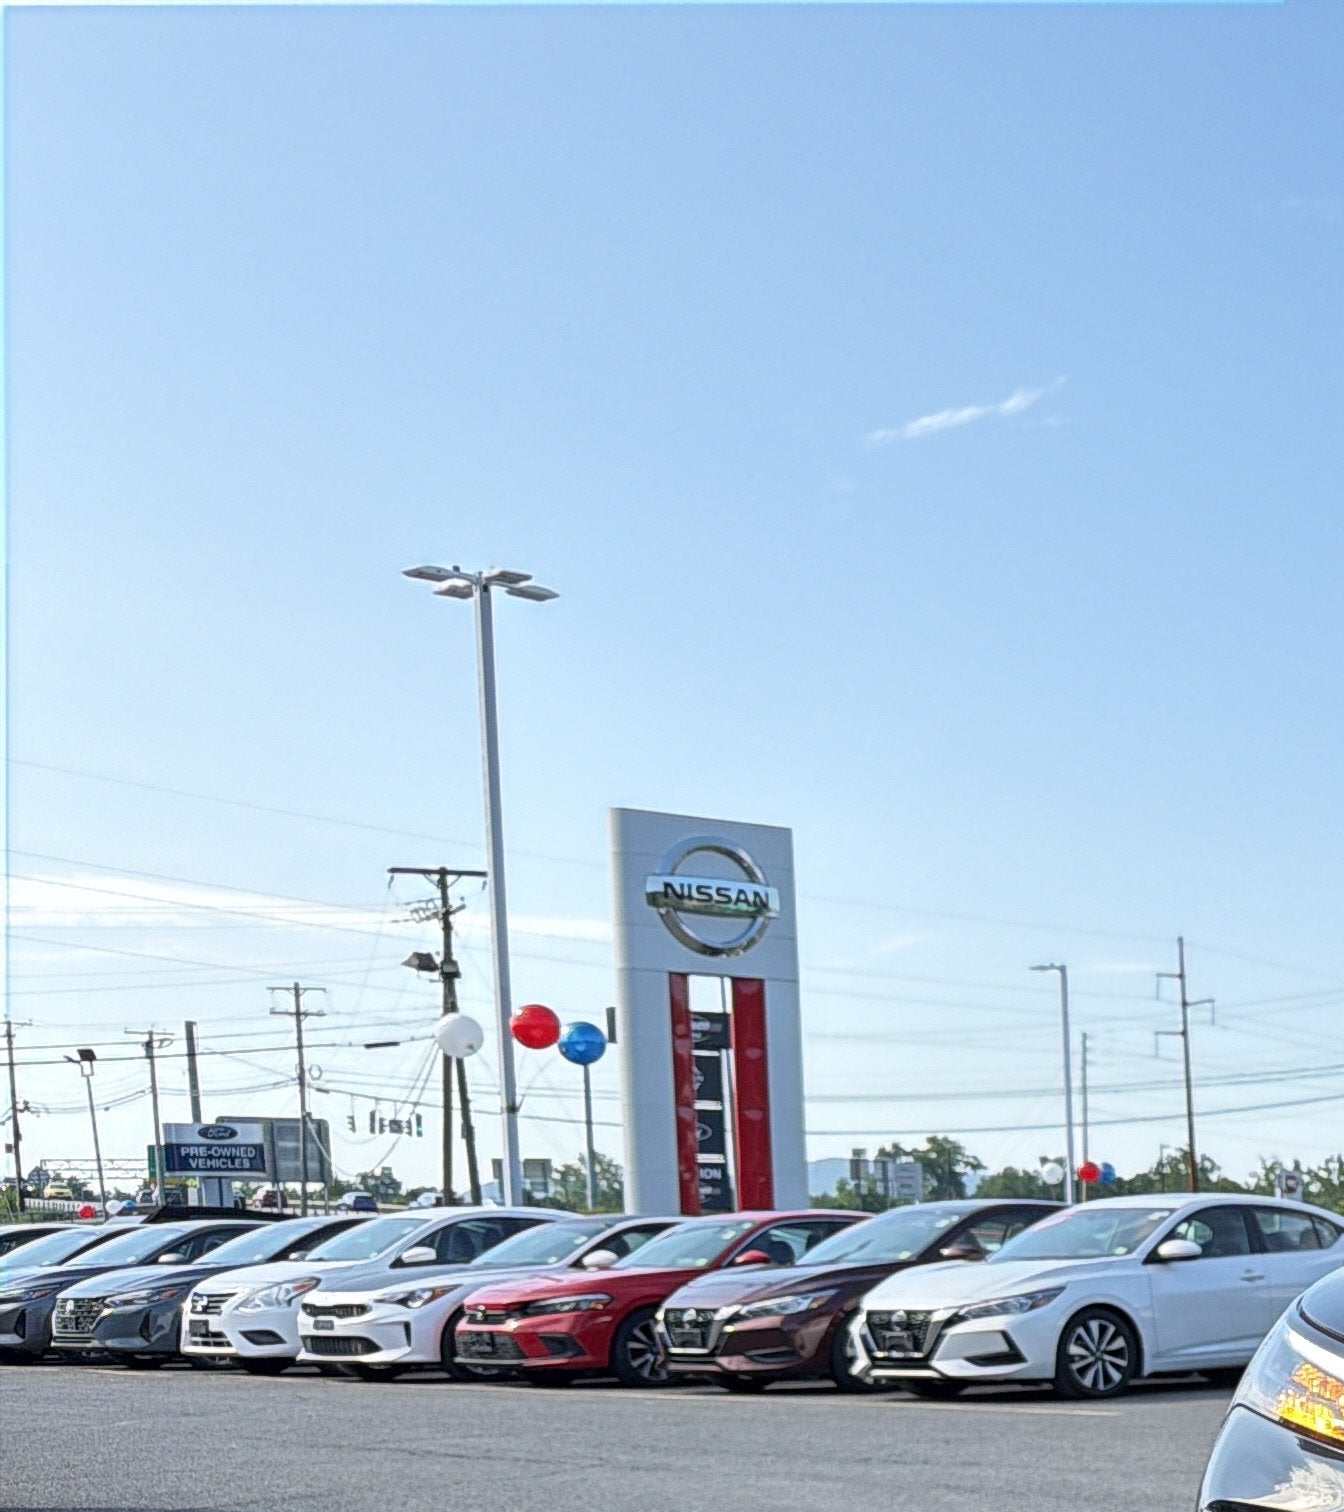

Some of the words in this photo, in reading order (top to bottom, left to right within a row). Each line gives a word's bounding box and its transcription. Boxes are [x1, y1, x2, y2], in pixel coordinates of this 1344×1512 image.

[663, 882, 769, 909] NISSAN
[180, 1146, 256, 1158] PRE-OWNED
[188, 1158, 251, 1169] VEHICLES
